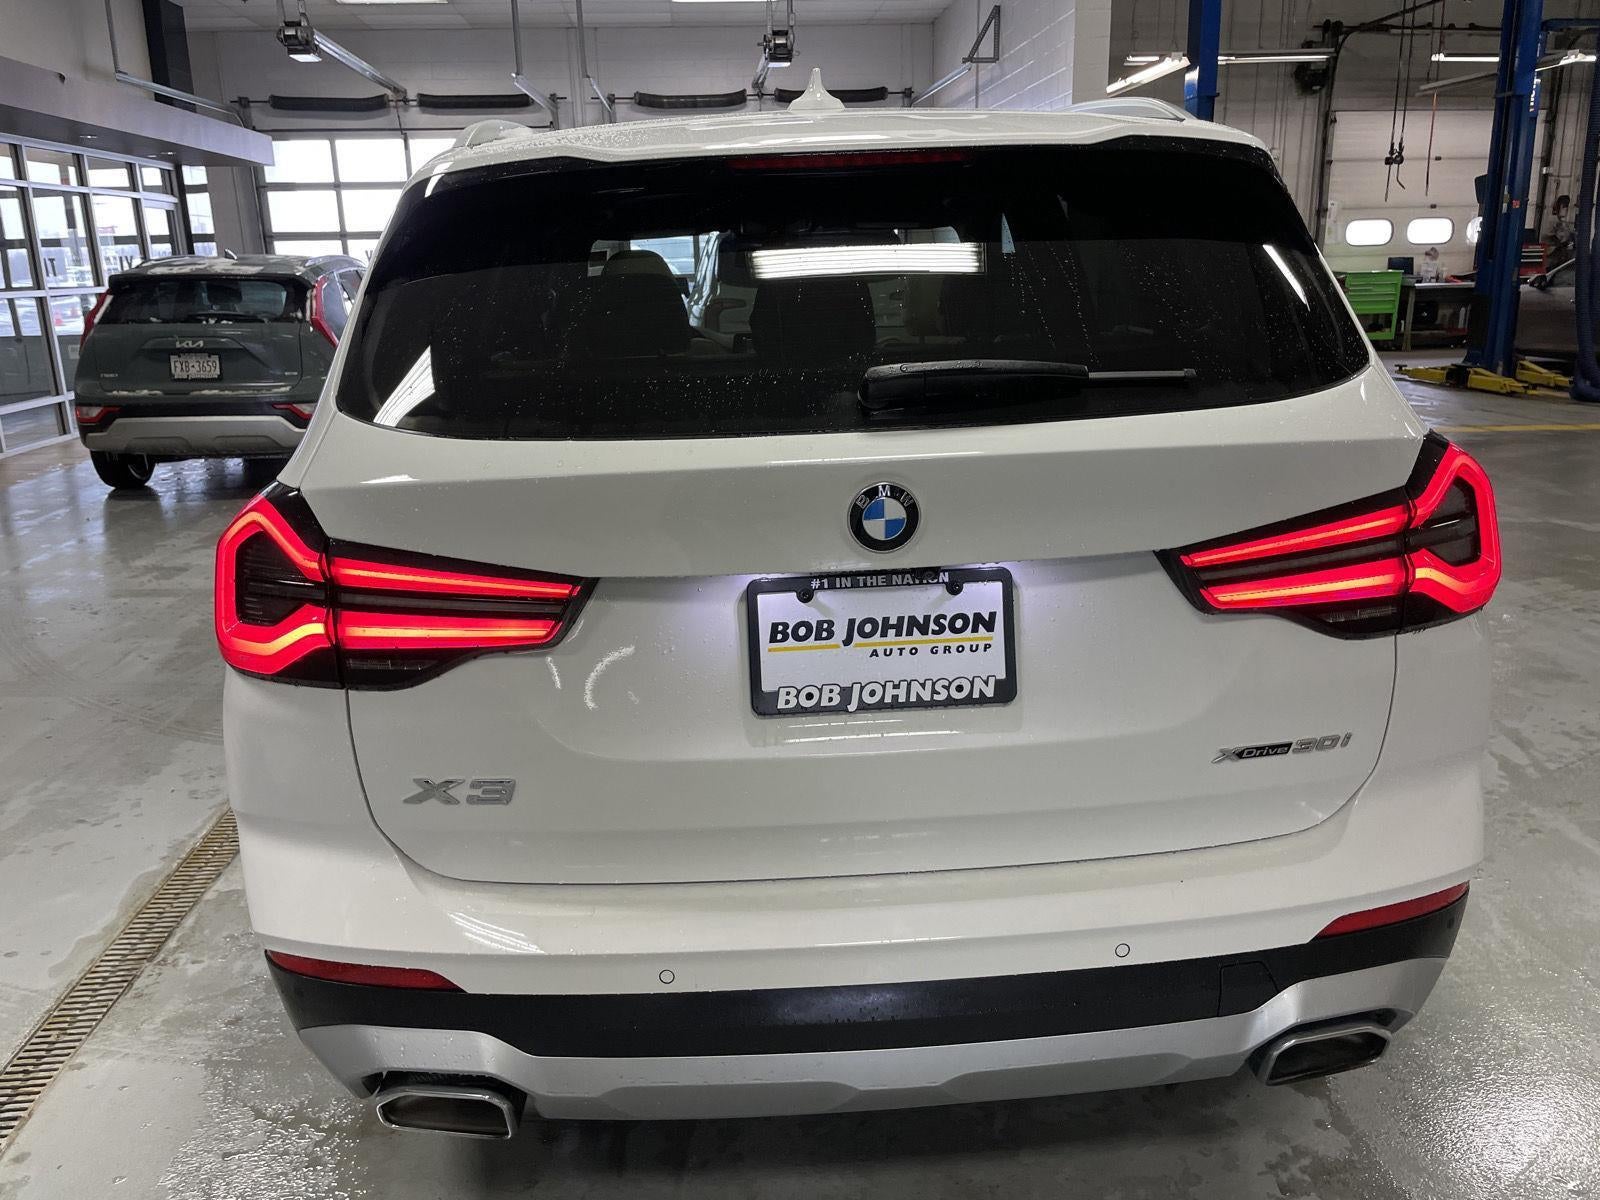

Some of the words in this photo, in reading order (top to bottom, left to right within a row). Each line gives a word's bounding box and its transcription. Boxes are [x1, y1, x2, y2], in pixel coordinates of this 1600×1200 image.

[855, 484, 915, 510] BMW
[810, 577, 829, 590] #1
[835, 576, 852, 588] IN
[856, 575, 887, 587] THE
[768, 619, 836, 644] BOB
[842, 611, 997, 646] JOHNSON
[869, 646, 919, 658] AUTO
[929, 643, 993, 655] GROUP
[776, 684, 842, 710] BOB
[846, 674, 997, 713] JOHNSON
[402, 777, 517, 805] X3
